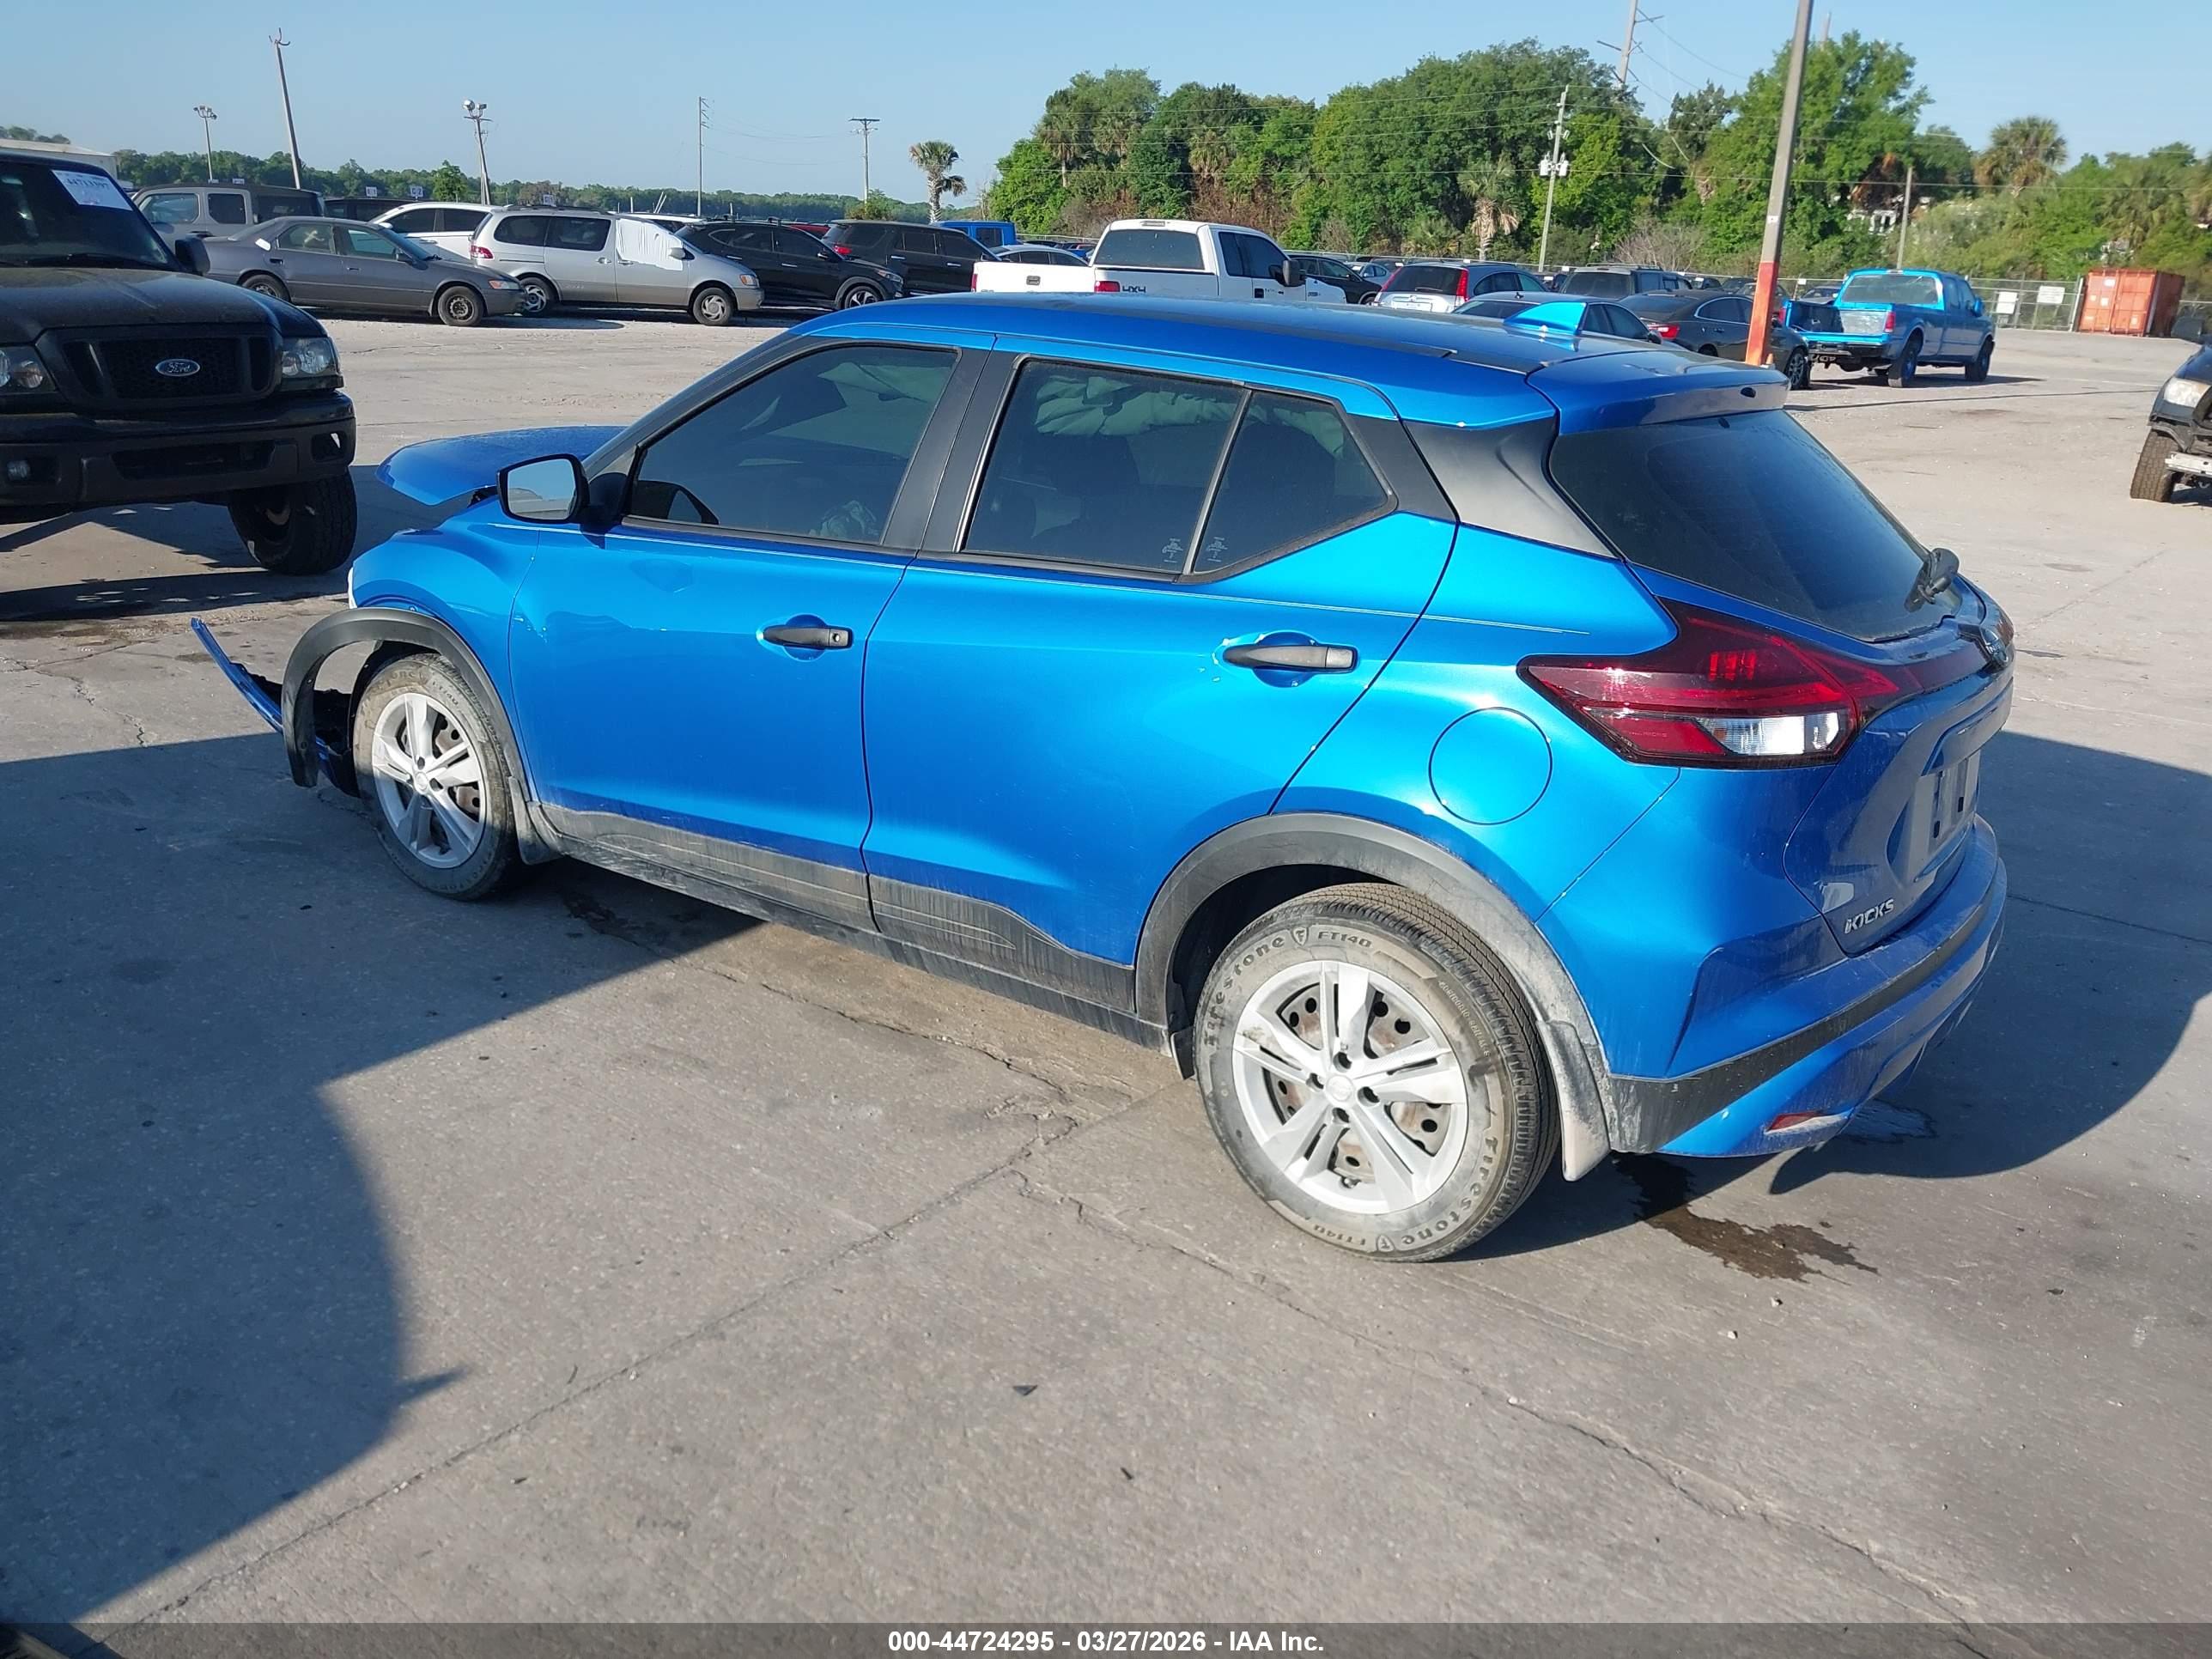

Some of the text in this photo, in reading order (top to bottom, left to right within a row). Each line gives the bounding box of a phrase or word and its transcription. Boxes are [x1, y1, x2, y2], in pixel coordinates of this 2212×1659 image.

[1844, 898, 1894, 934] KICKS
[1318, 931, 1373, 948] FT140
[1401, 1136, 1498, 1246] Firestone
